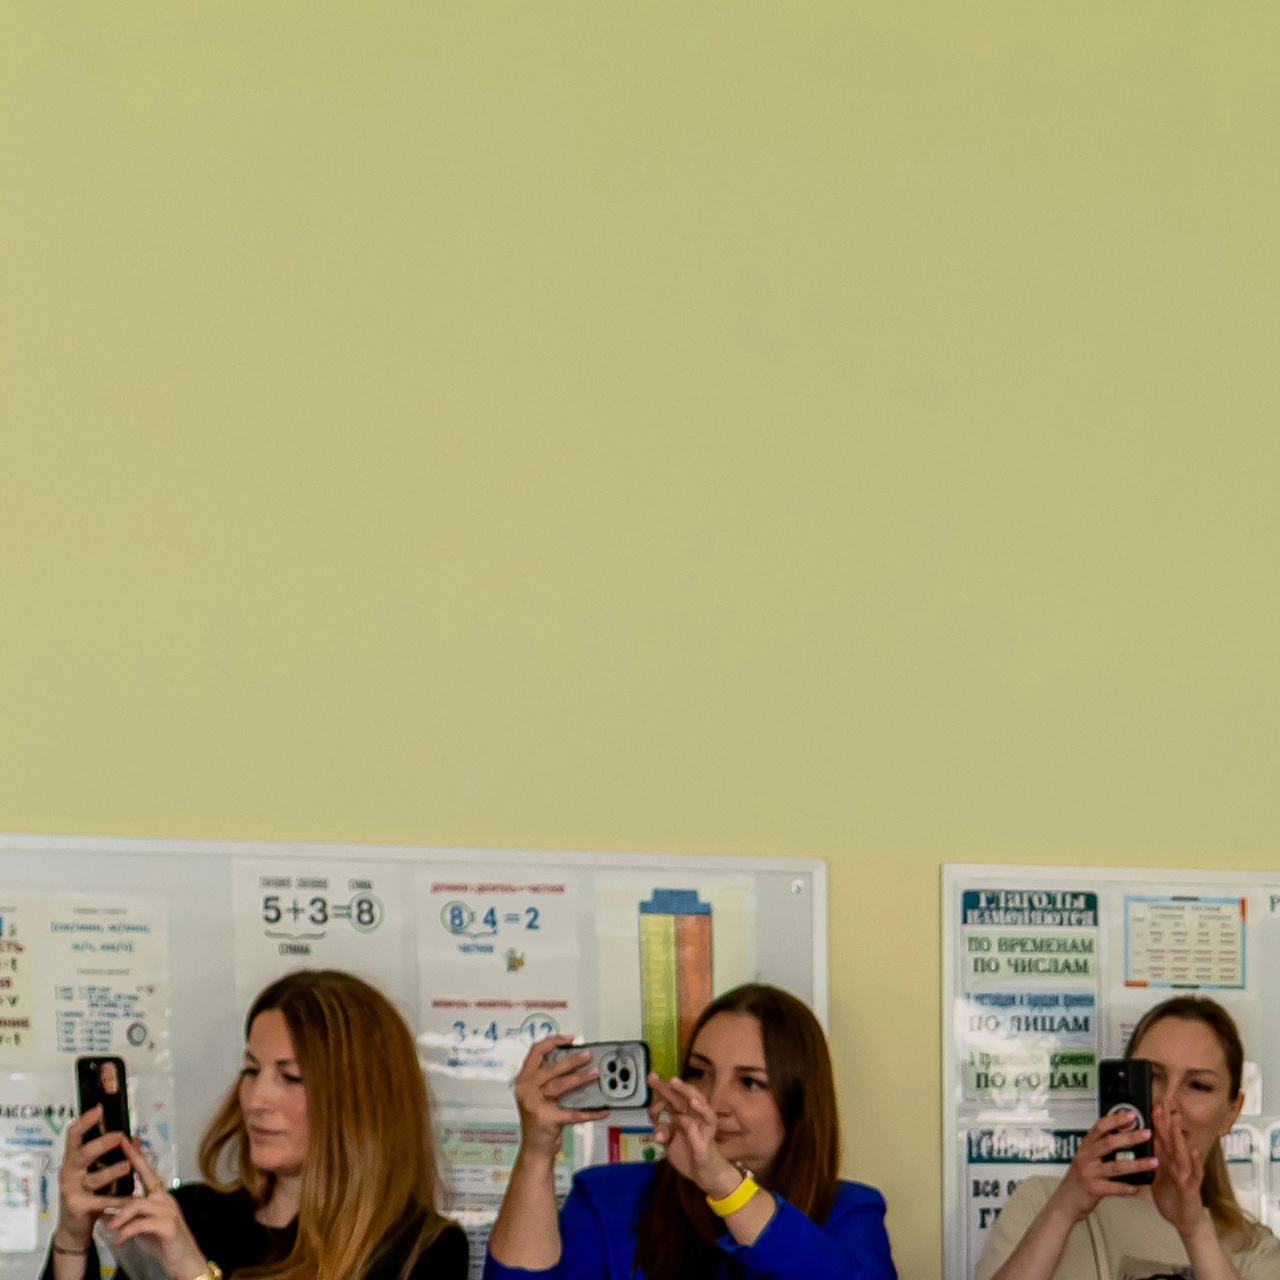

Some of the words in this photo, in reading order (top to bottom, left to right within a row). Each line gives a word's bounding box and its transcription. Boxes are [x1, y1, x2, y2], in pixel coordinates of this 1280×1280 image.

[968, 936, 992, 952] ПО
[997, 937, 1094, 953] ВРЕМЕНАМ
[973, 957, 1000, 973] ПО
[1007, 957, 1089, 973] ЧИСЛАМ
[969, 1014, 1000, 1032] ПО
[1010, 1014, 1089, 1032] ЛИЦАМ
[976, 1072, 1006, 1089] ПО
